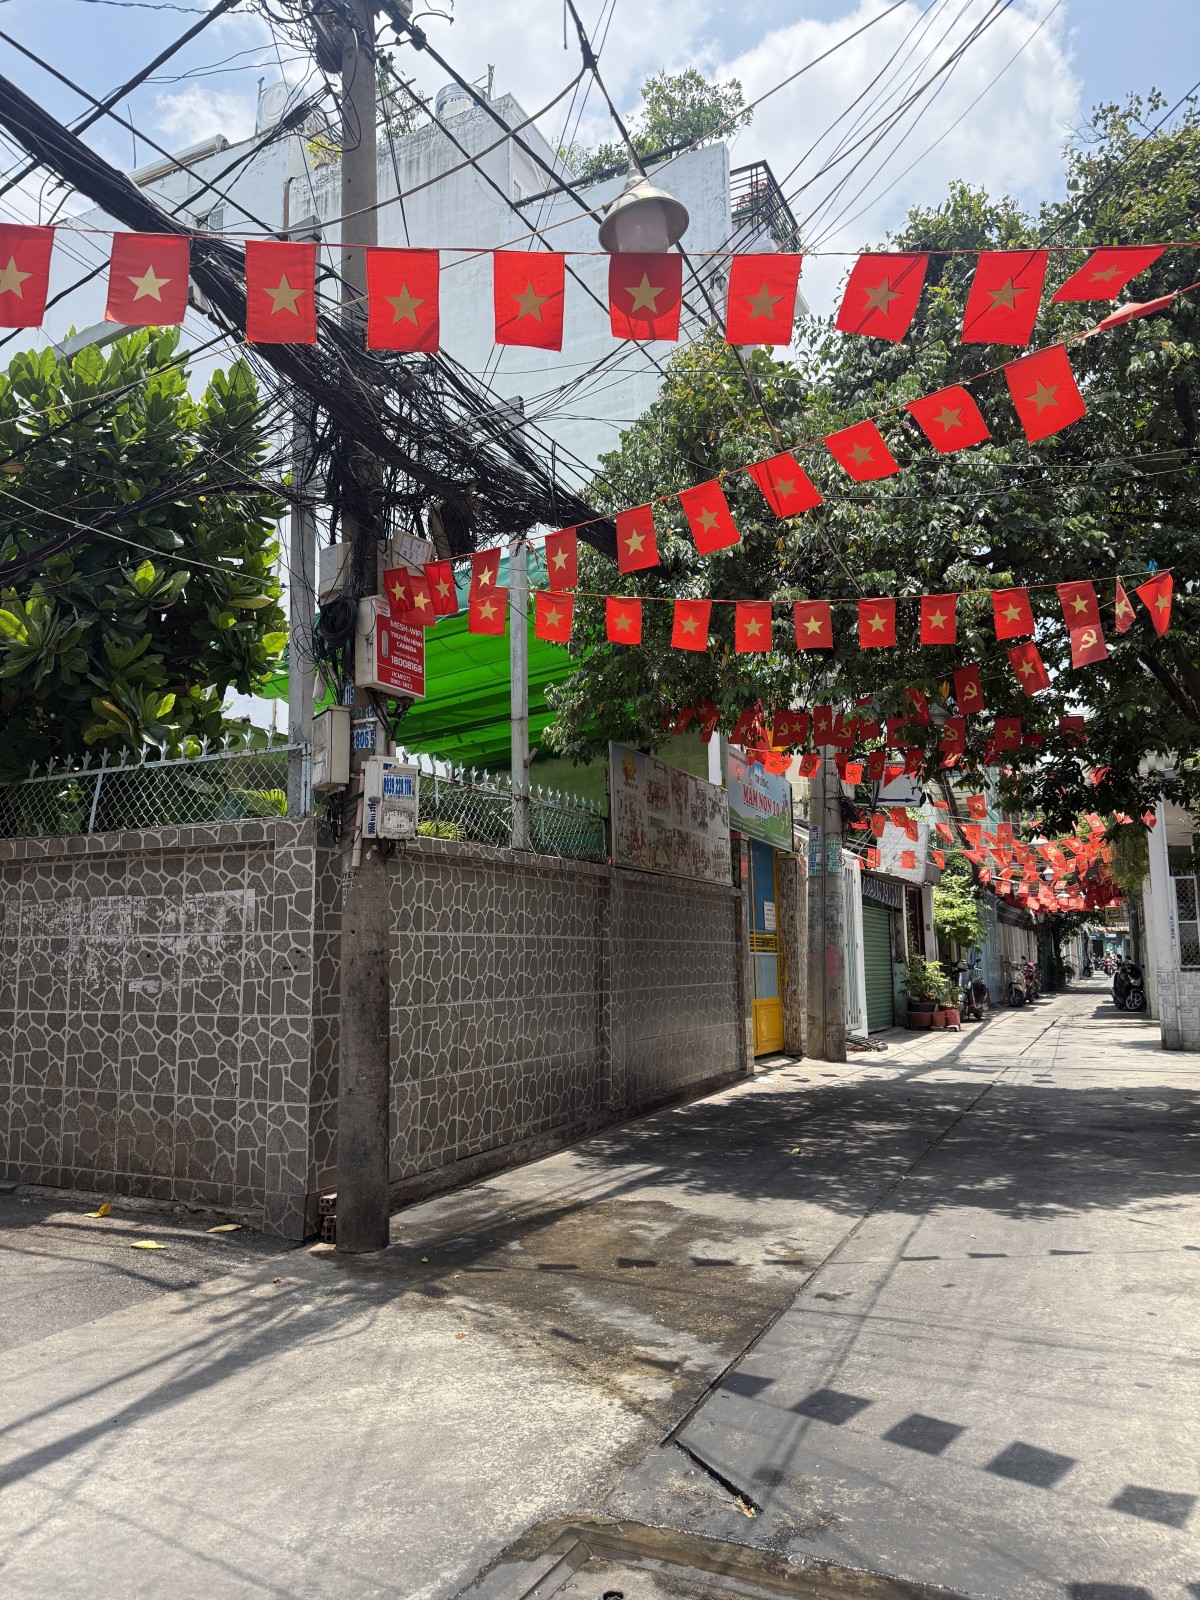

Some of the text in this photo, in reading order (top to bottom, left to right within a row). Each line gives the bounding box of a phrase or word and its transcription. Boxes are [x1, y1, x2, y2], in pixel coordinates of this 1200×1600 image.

[390, 620, 423, 638] MESH-WIFI
[390, 655, 423, 673] 18008168
[759, 792, 772, 816] NON
